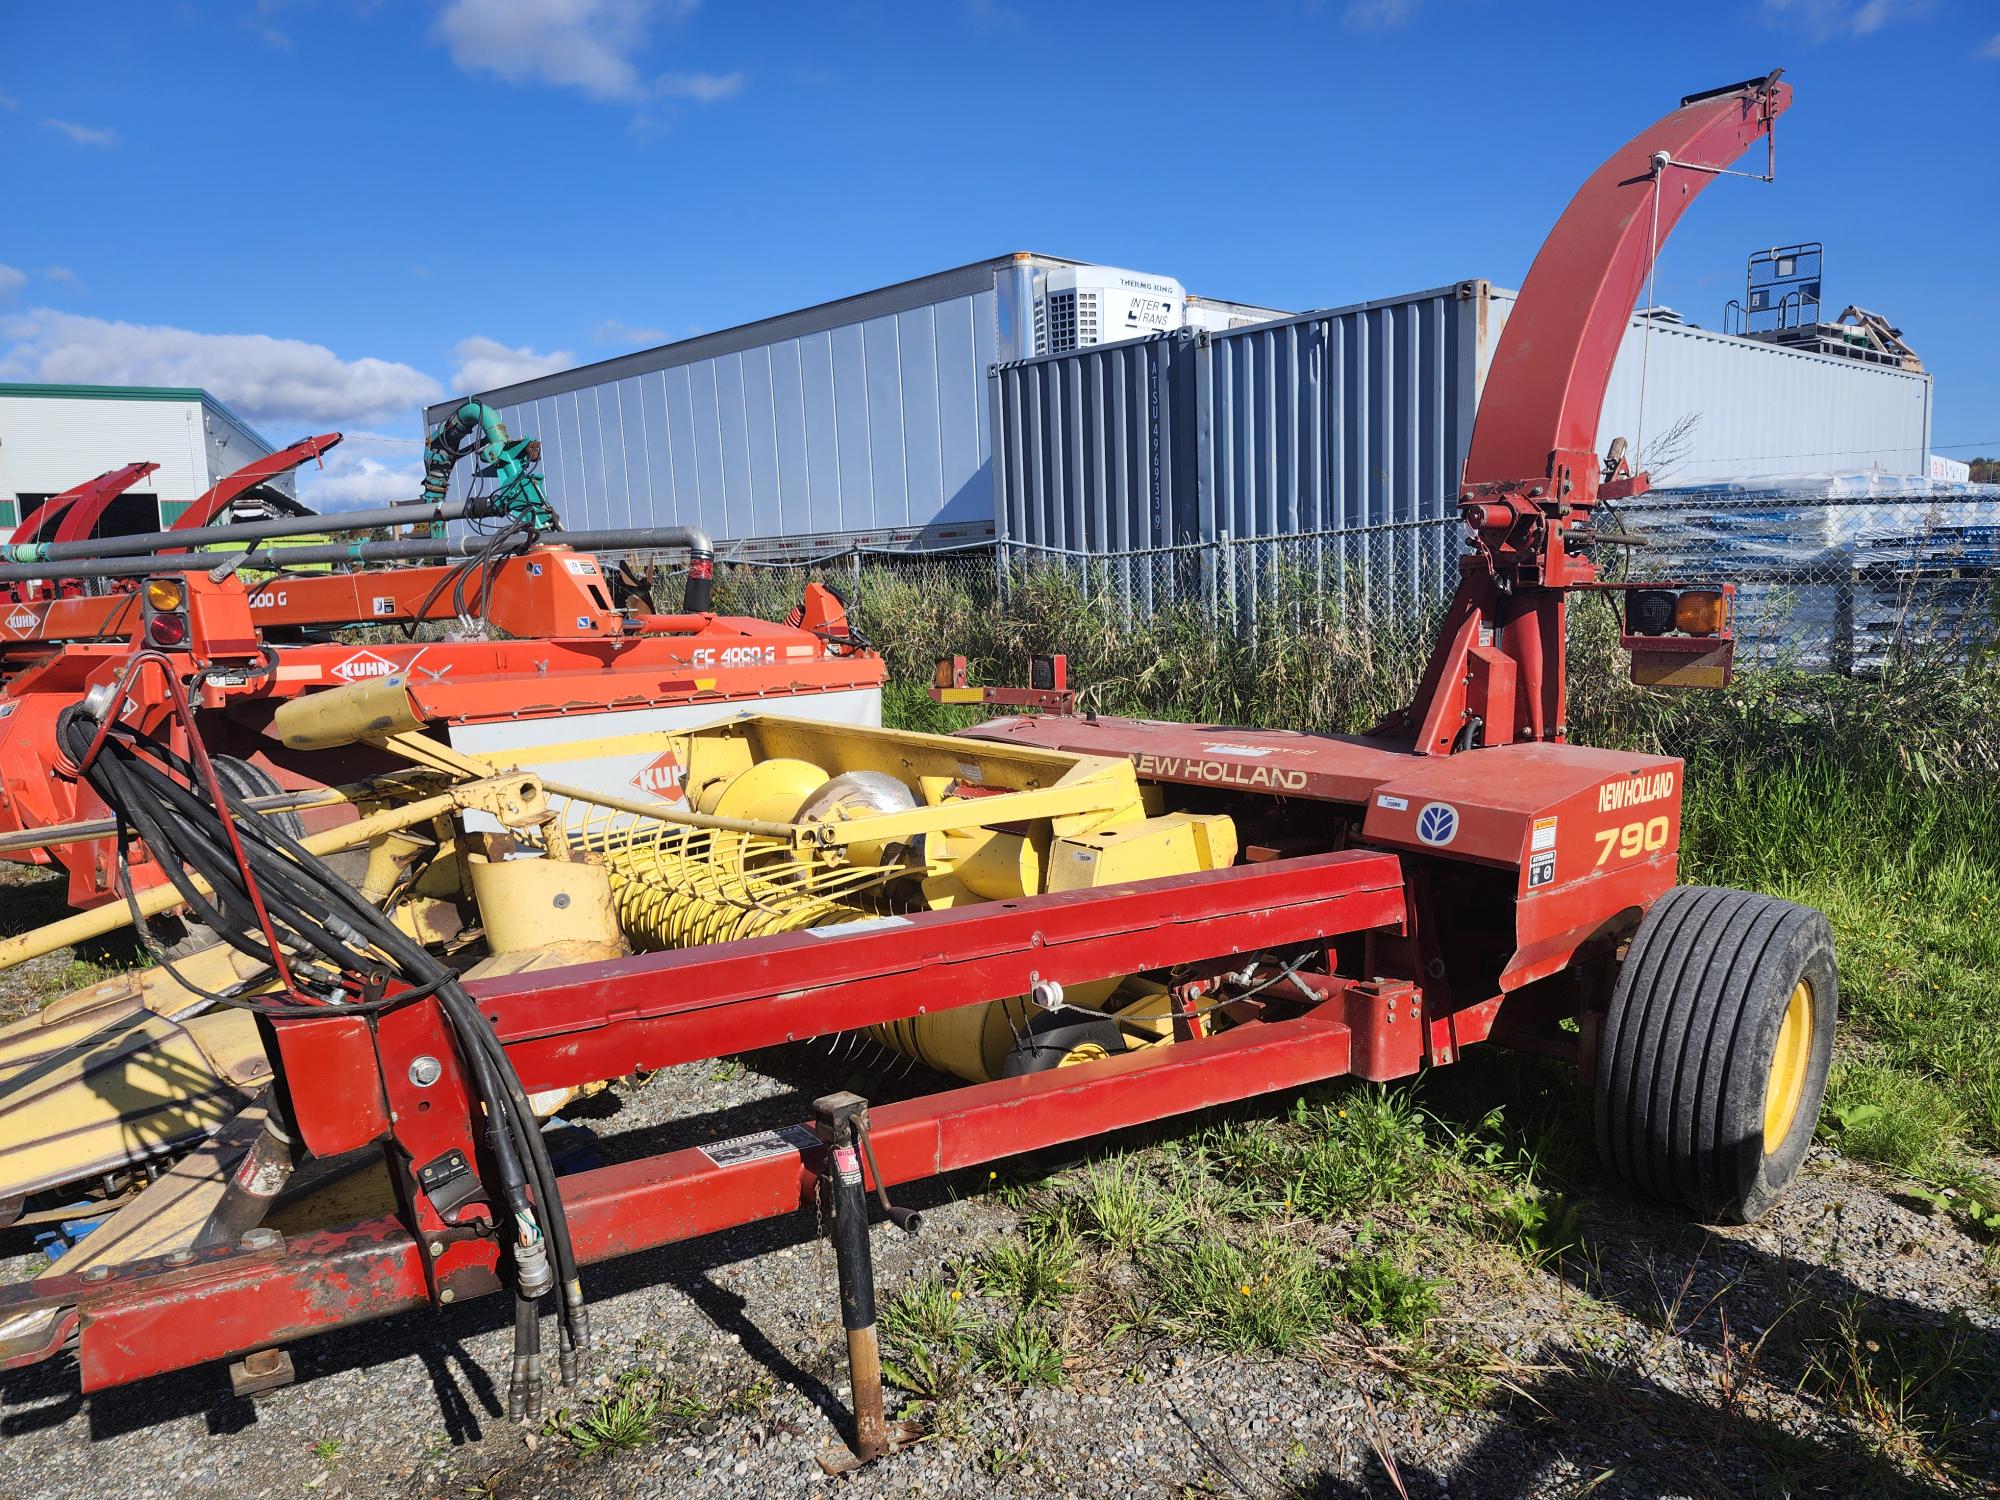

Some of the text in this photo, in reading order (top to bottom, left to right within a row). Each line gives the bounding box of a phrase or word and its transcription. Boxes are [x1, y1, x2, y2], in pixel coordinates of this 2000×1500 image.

[1120, 279, 1173, 293] THERMO KING
[1131, 297, 1160, 310] INTER
[1151, 361, 1159, 419] ATSU
[1152, 424, 1160, 510] 496933
[277, 591, 287, 606] G
[10, 615, 36, 628] KUHN
[693, 648, 716, 664] FC
[341, 662, 390, 677] KUHN
[640, 765, 687, 791] KUH
[1184, 760, 1307, 790] HOLLAND
[1598, 771, 1674, 813] NEW HOLLAND
[1595, 816, 1669, 866] 790
